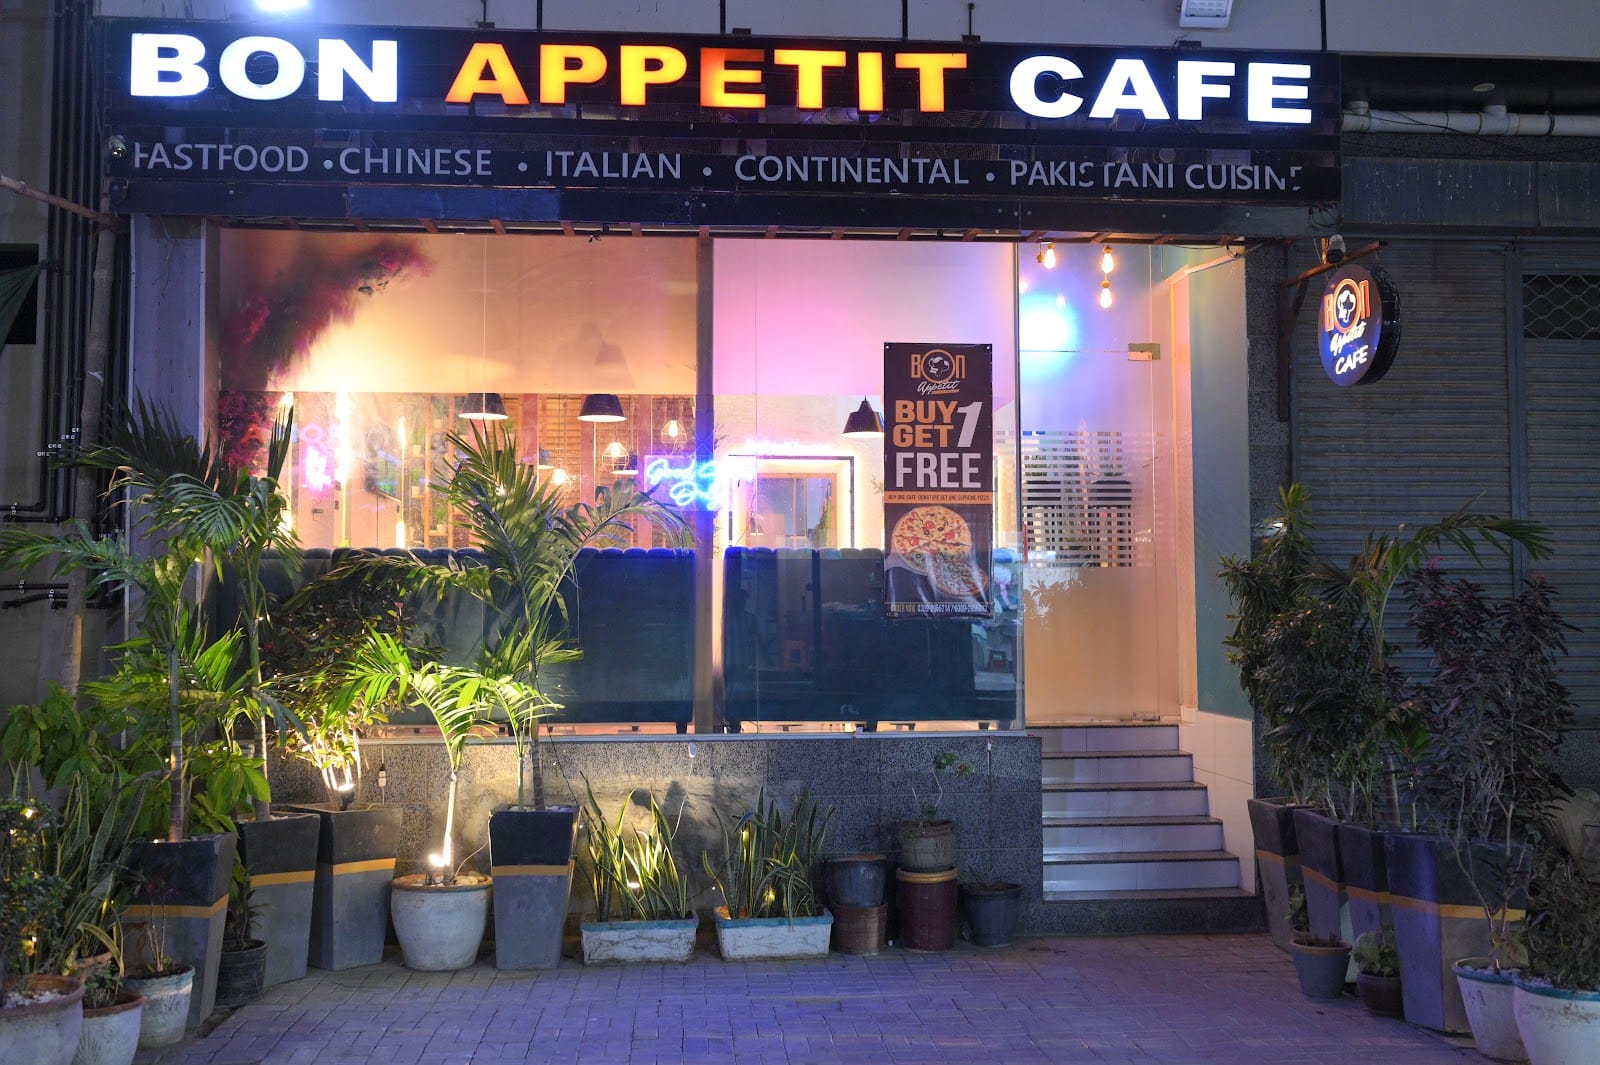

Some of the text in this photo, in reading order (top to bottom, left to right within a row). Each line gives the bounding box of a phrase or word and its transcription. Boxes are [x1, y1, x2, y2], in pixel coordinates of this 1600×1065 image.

[130, 32, 1312, 125] BON APPETIT CAFE
[134, 142, 309, 172] FASTFOOD
[339, 147, 492, 175] CHINESE
[546, 150, 681, 179] ITALIAN
[735, 155, 969, 184] CONTINENTAL
[1010, 160, 1174, 188] PAKISTANI
[1323, 278, 1371, 333] BON
[911, 349, 966, 383] BON
[1335, 345, 1369, 375] CAFE
[895, 399, 958, 424] BUY
[956, 401, 983, 448] 1
[892, 423, 954, 448] GET
[895, 451, 981, 488] FREE
